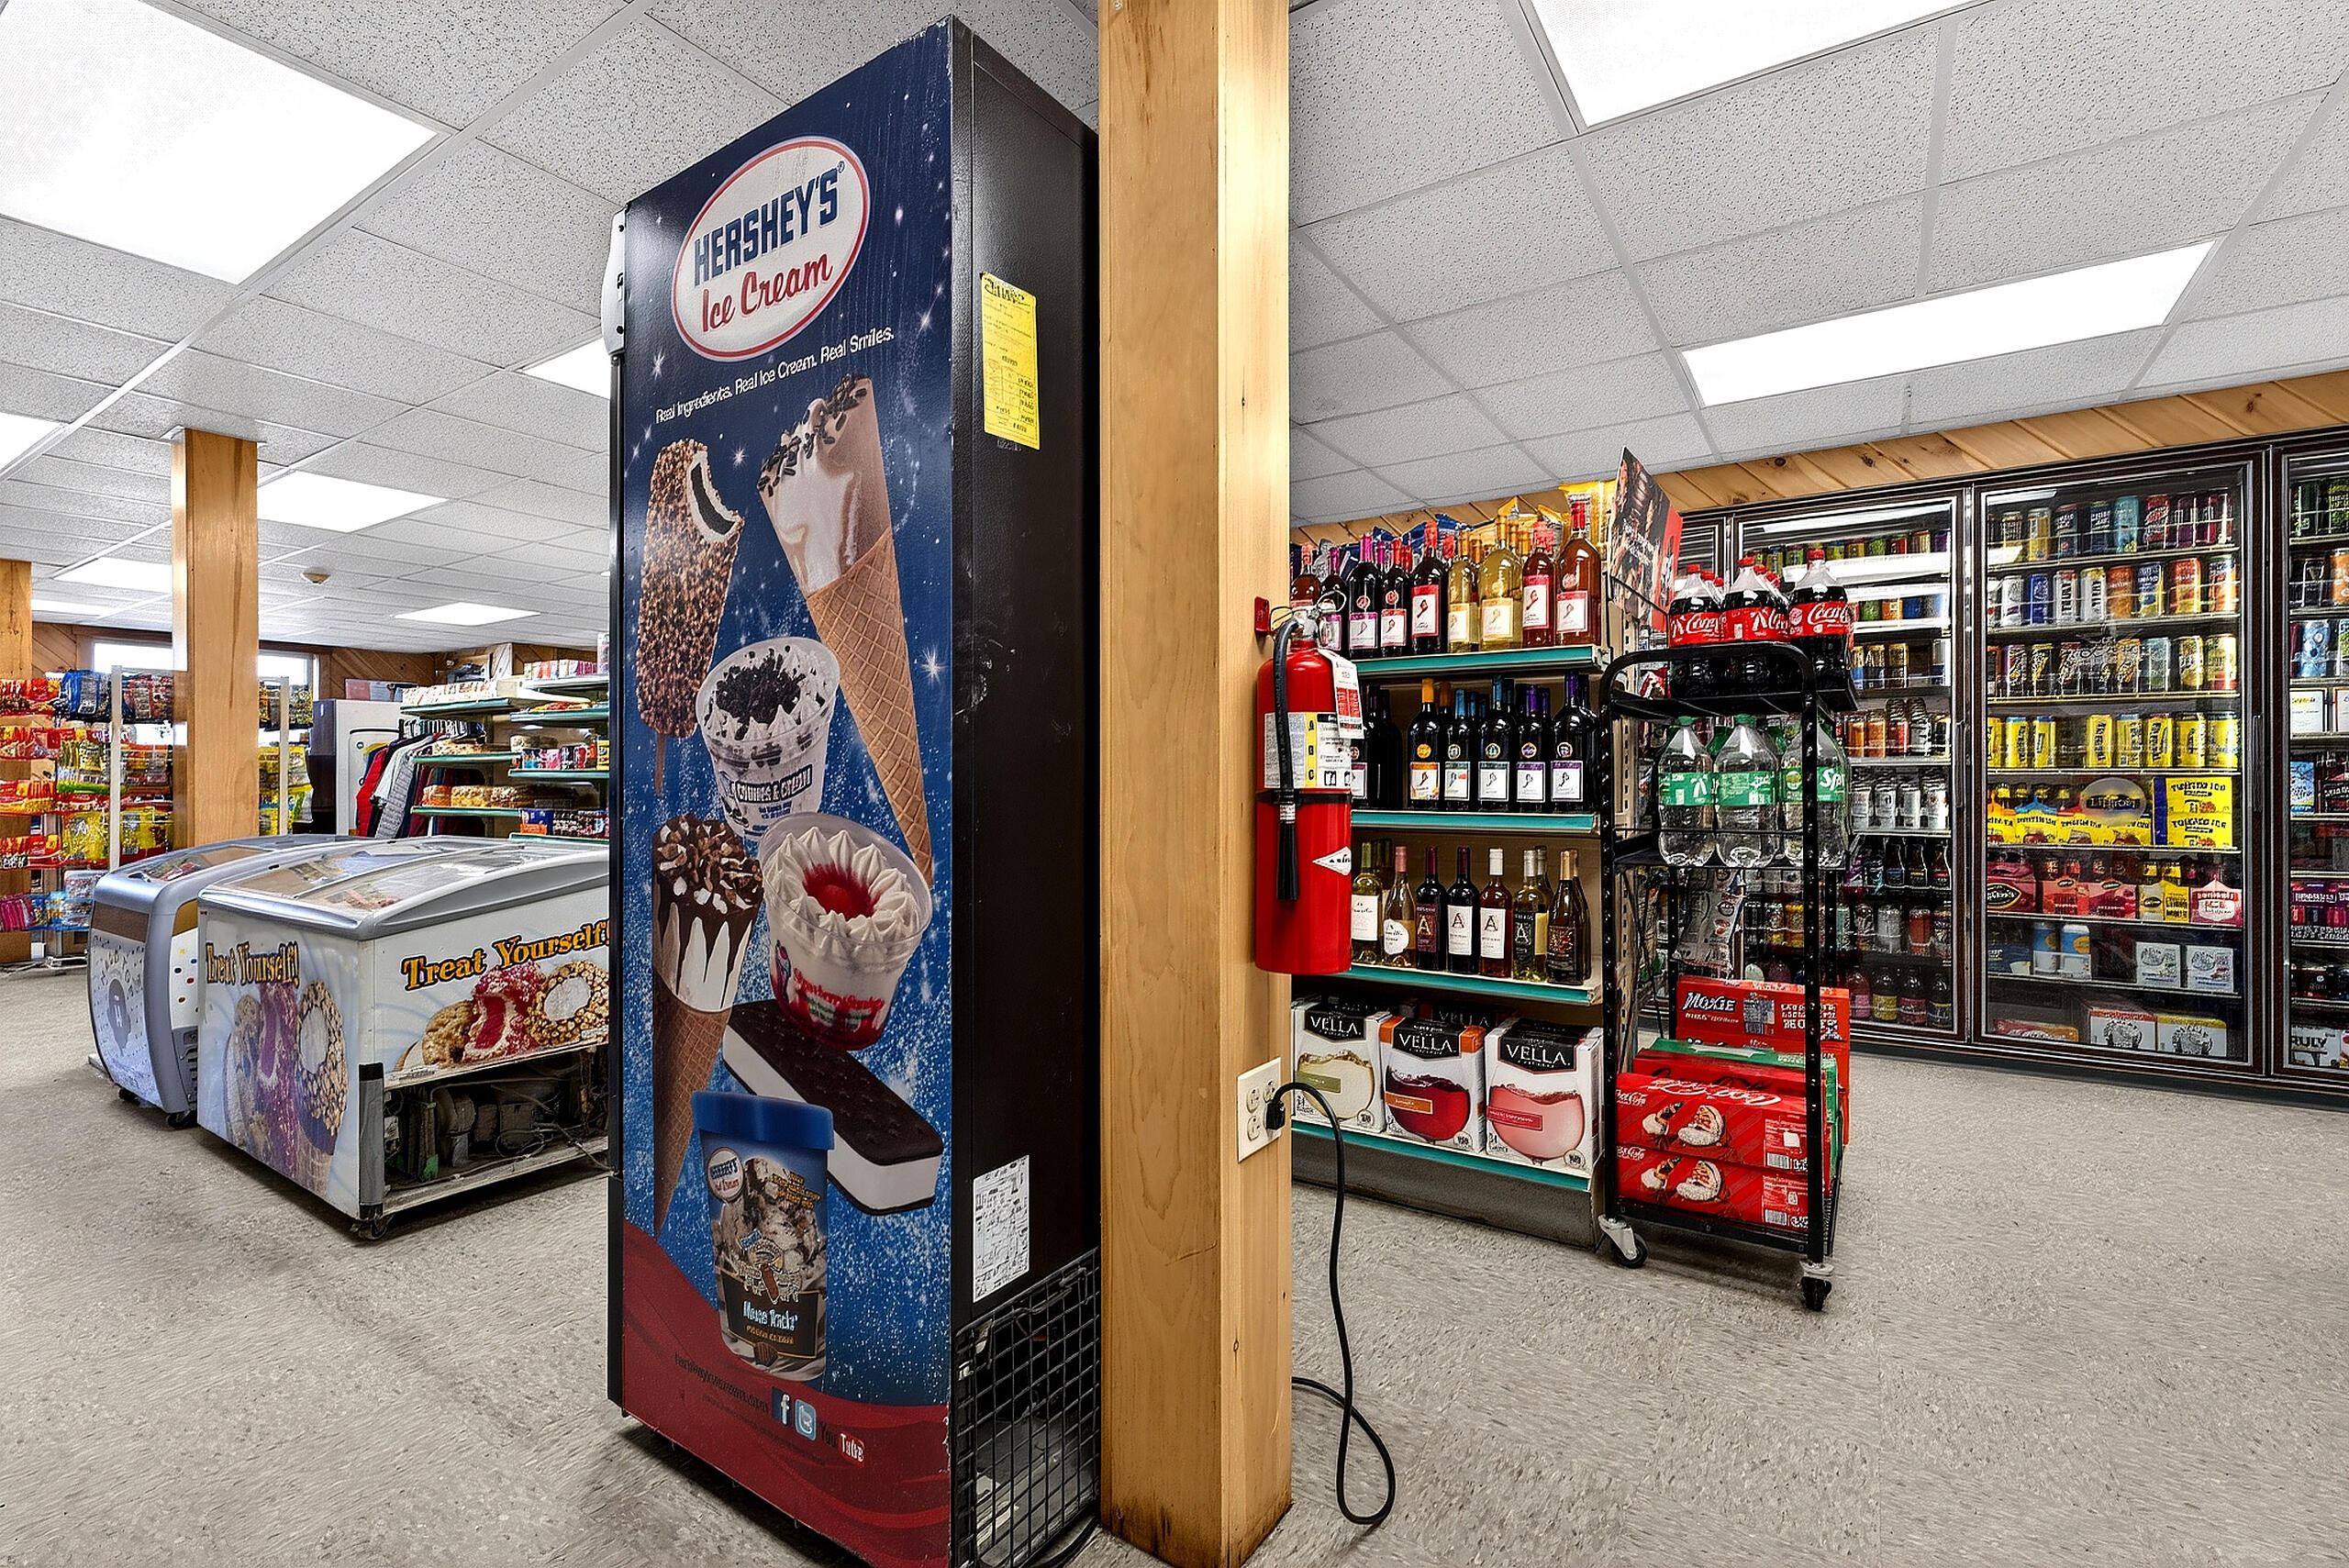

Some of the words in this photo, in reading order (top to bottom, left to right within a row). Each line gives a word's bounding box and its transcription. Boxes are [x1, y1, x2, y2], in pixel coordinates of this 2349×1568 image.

[694, 168, 839, 287] HERSHEY'S
[702, 289, 735, 332] Ice
[740, 253, 833, 316] Cream
[655, 404, 675, 424] Real
[735, 376, 758, 395] Real
[760, 369, 776, 387] Ice
[820, 340, 846, 364] Real
[850, 326, 895, 354] Smiles.
[402, 949, 486, 990] Treat
[492, 918, 610, 968] Yourself!
[1682, 992, 1738, 1012] MOXIE
[1310, 1016, 1359, 1036] VELLA
[1398, 1033, 1453, 1052] VELLA
[1506, 1043, 1568, 1066] VELLA
